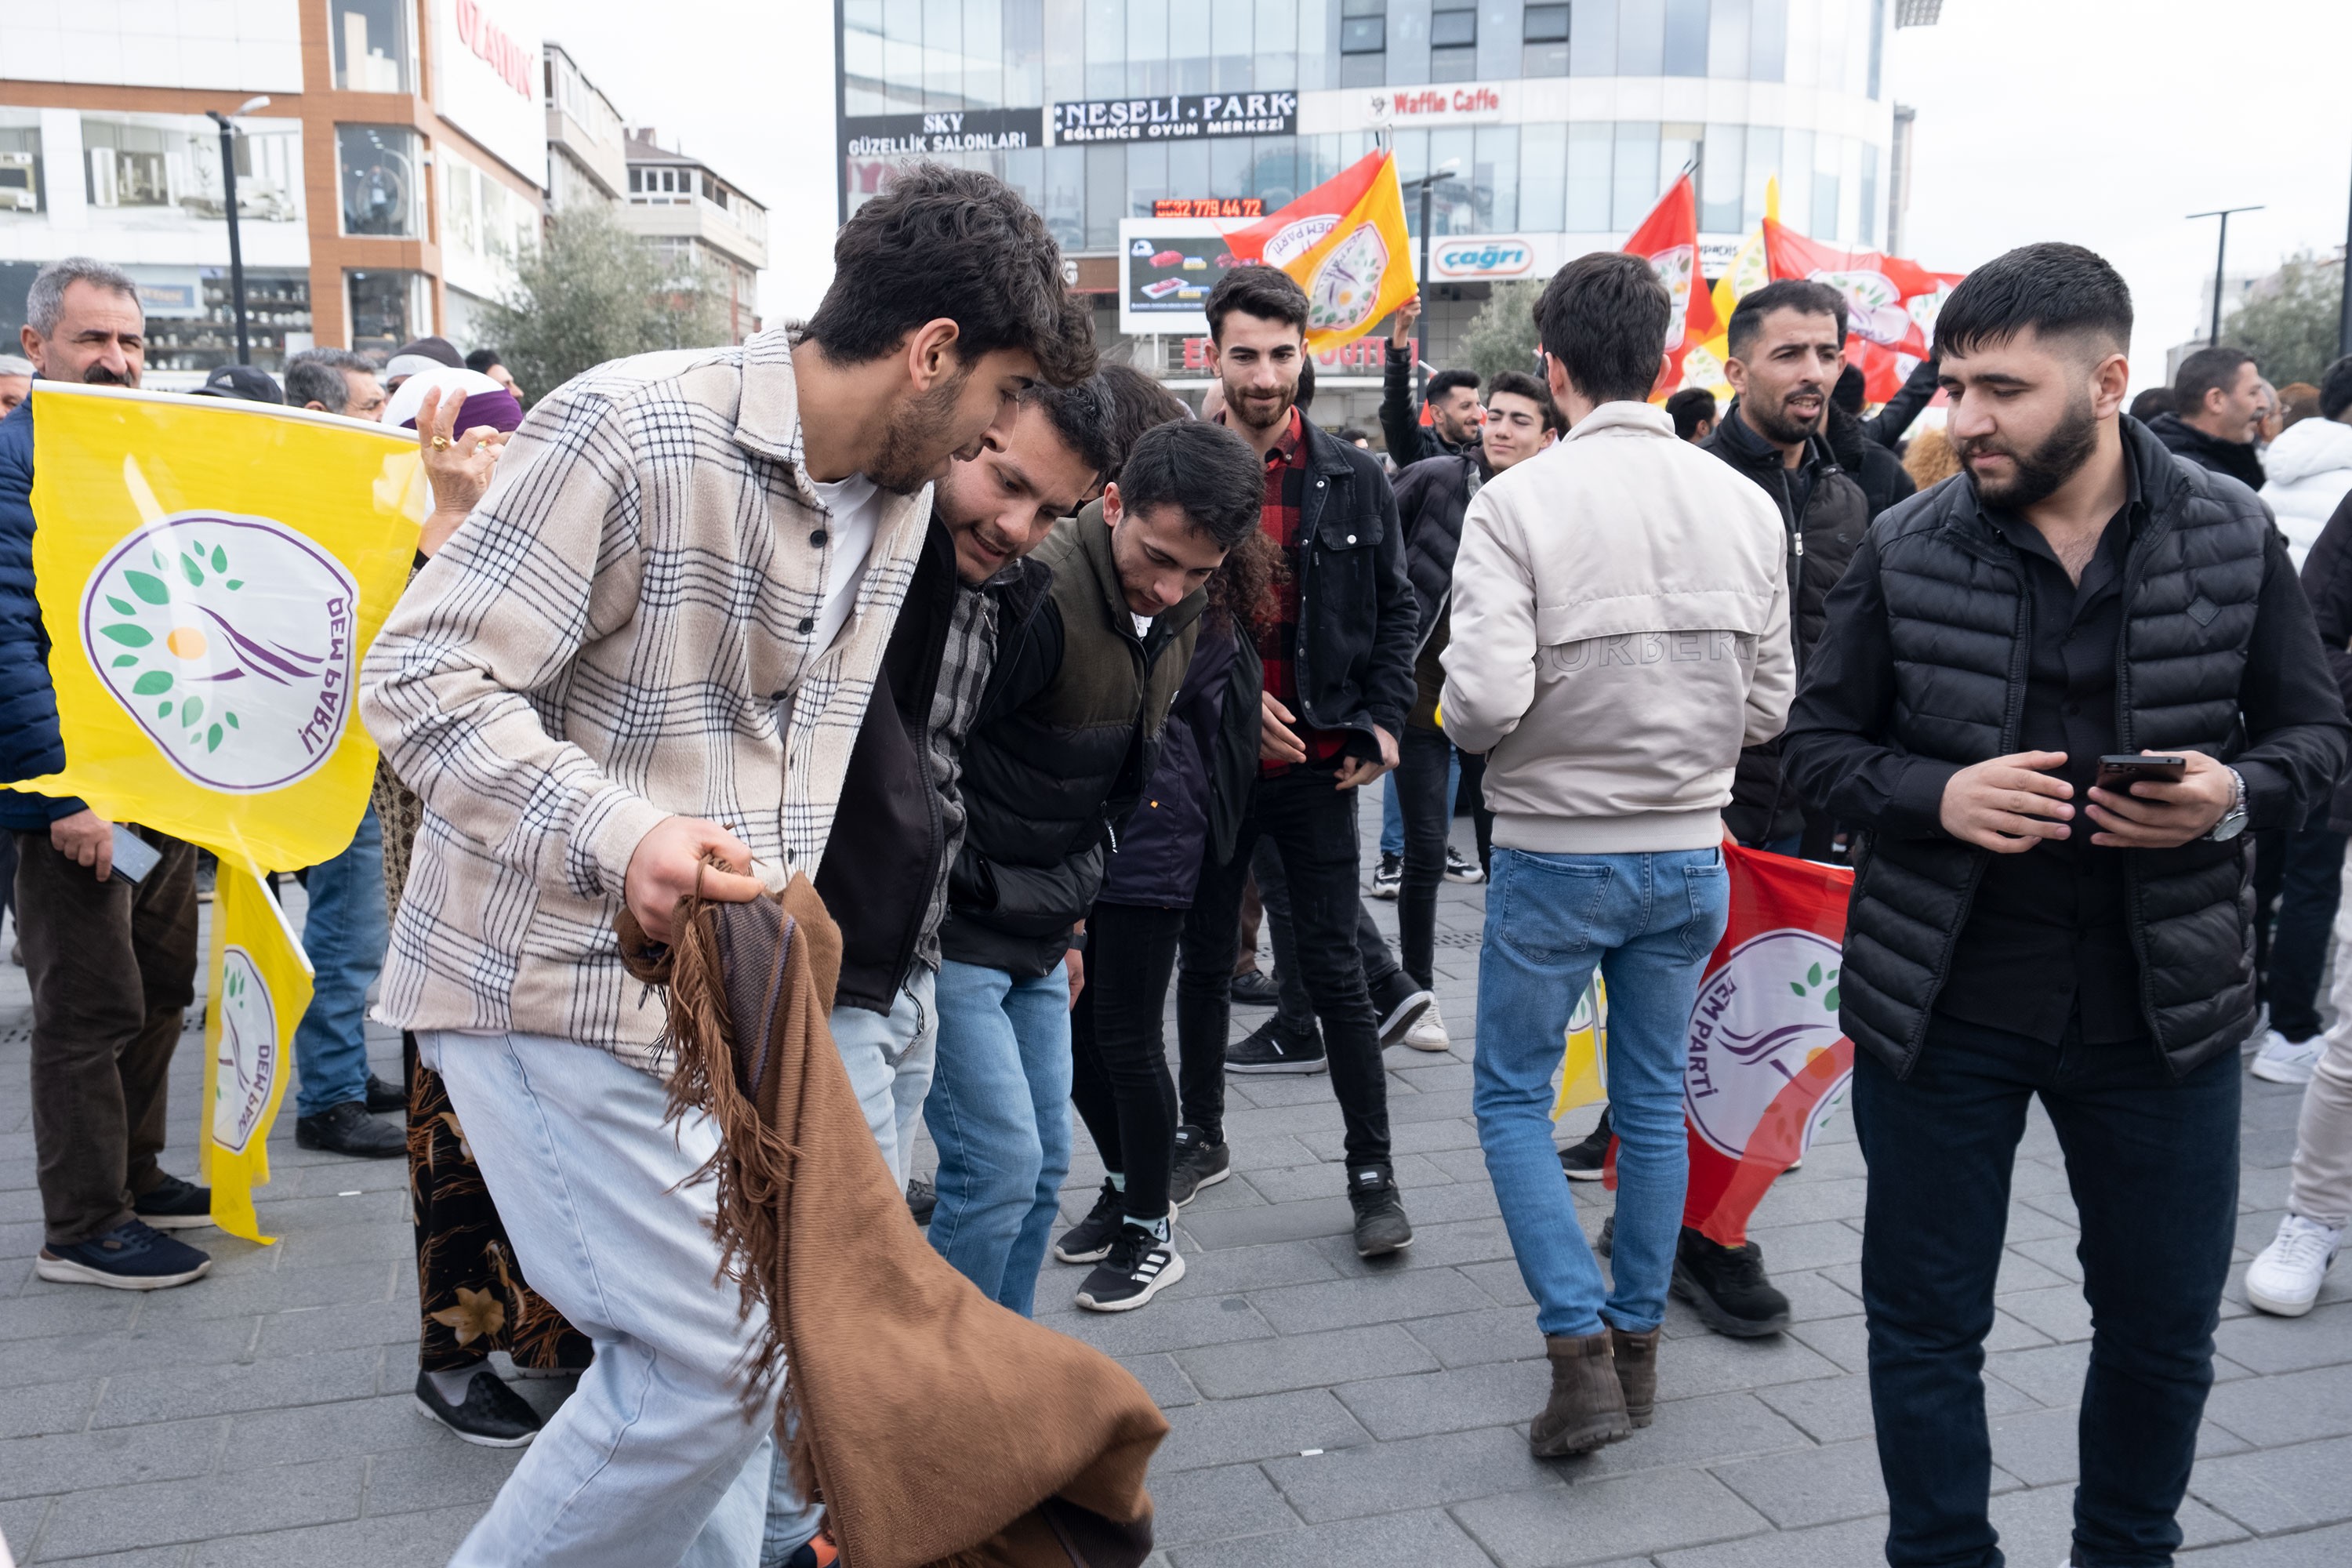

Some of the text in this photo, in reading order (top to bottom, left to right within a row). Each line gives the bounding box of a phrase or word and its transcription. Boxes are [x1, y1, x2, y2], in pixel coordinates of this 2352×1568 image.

[1065, 93, 1294, 127] NEŞELİ PARK
[1453, 88, 1499, 112] Caffe
[923, 113, 964, 134] SKY
[1063, 117, 1284, 142] EĞLENCE OYUN MERKEZİ
[848, 132, 1026, 155] GÜZELLİK SALONLARI
[1192, 199, 1220, 217] 779
[1221, 199, 1240, 216] 44
[1242, 198, 1261, 216] 72
[1689, 1019, 1719, 1099] PARTİ
